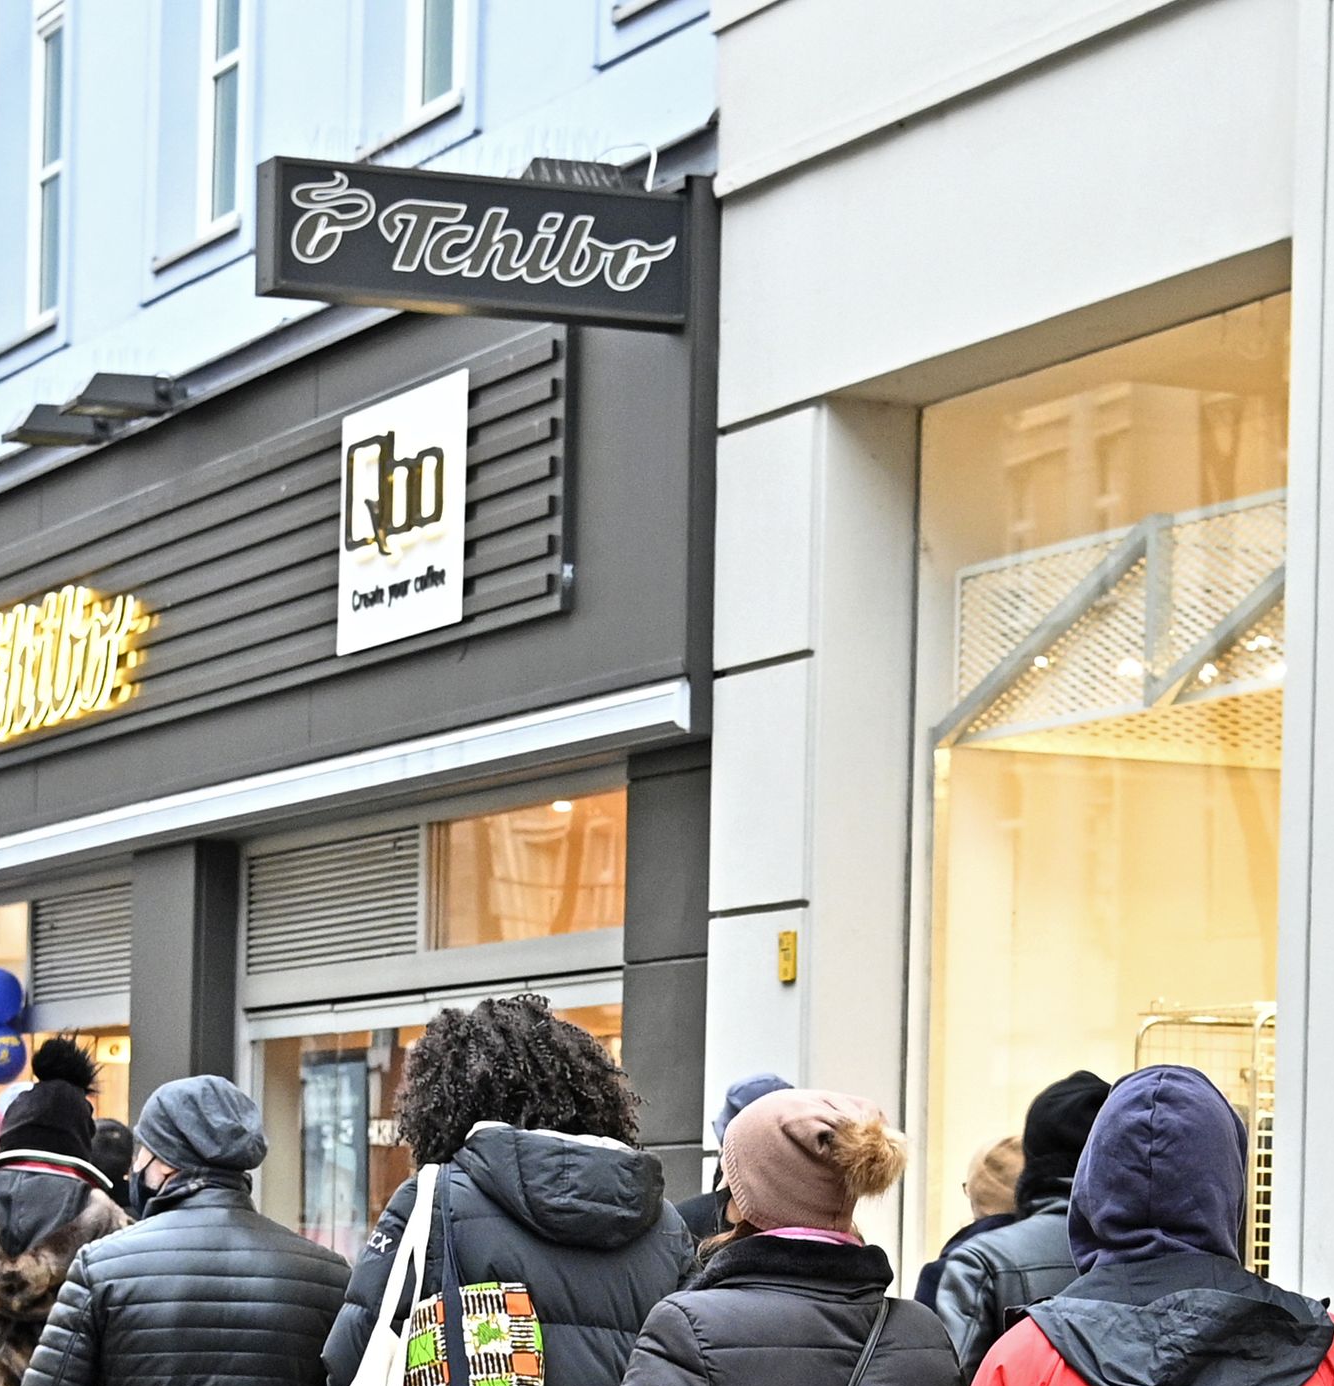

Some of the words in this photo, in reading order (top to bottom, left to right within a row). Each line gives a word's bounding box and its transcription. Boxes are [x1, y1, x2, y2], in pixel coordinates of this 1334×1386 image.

[377, 198, 677, 292] Tchibo
[345, 430, 444, 556] Qbo
[352, 584, 384, 612] Create
